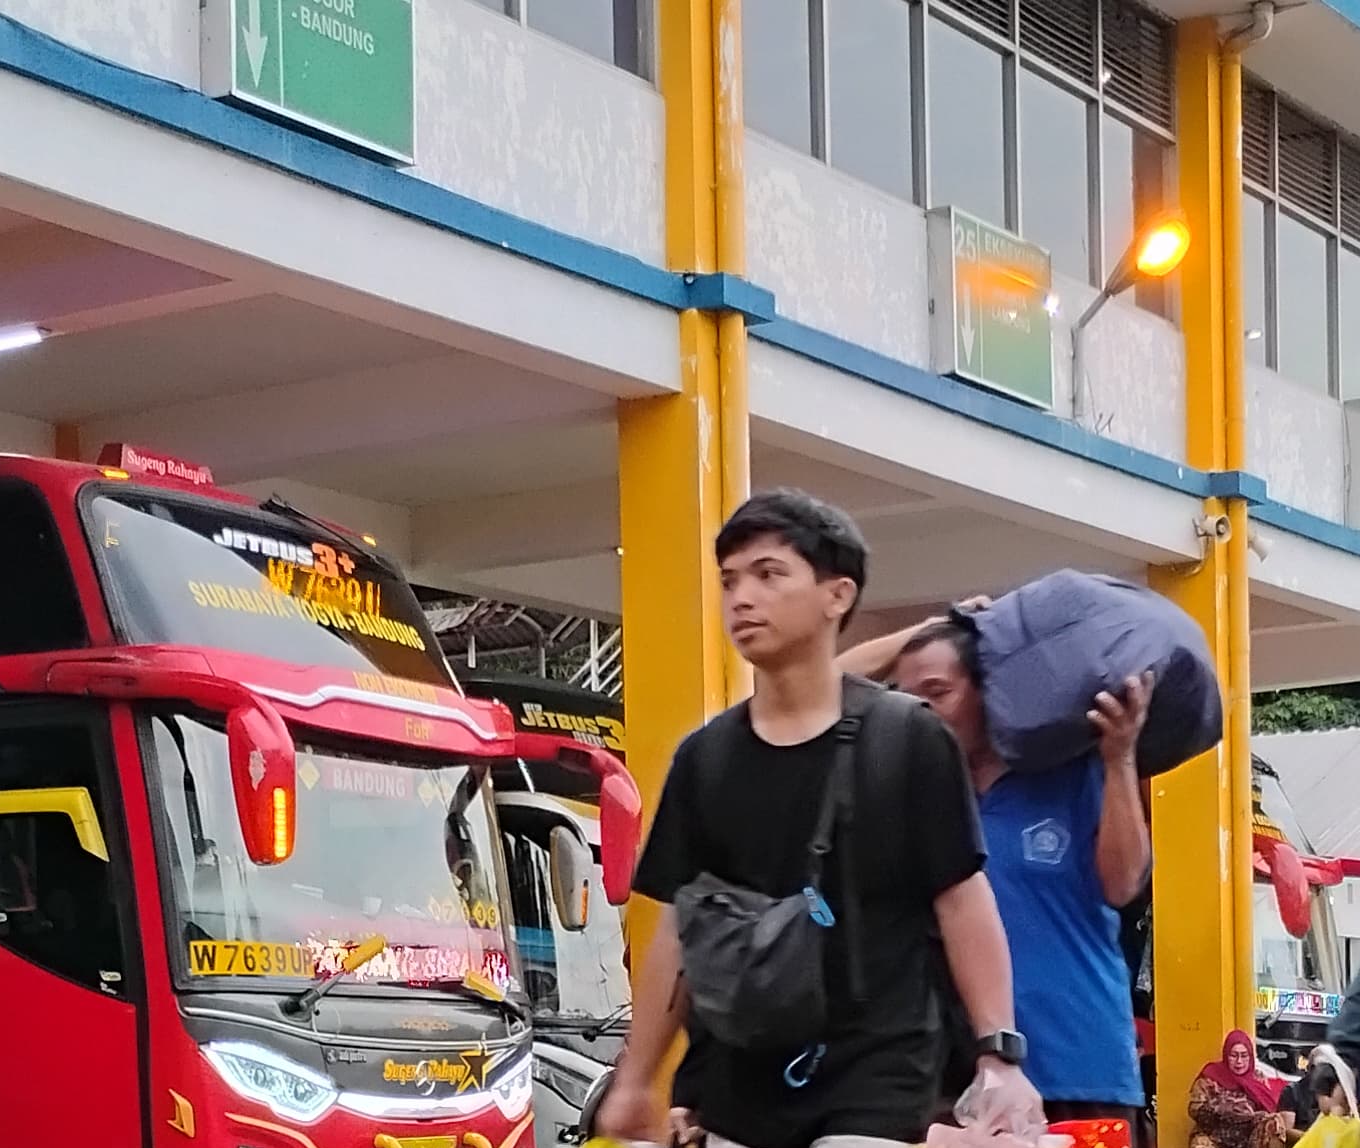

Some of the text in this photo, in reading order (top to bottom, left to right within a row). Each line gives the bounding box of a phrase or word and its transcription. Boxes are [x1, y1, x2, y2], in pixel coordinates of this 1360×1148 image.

[955, 223, 977, 263] 25
[127, 449, 207, 485] Sugeng Rahayu
[332, 767, 406, 799] BANDUNG
[193, 945, 217, 971] W
[223, 944, 286, 974] 7639
